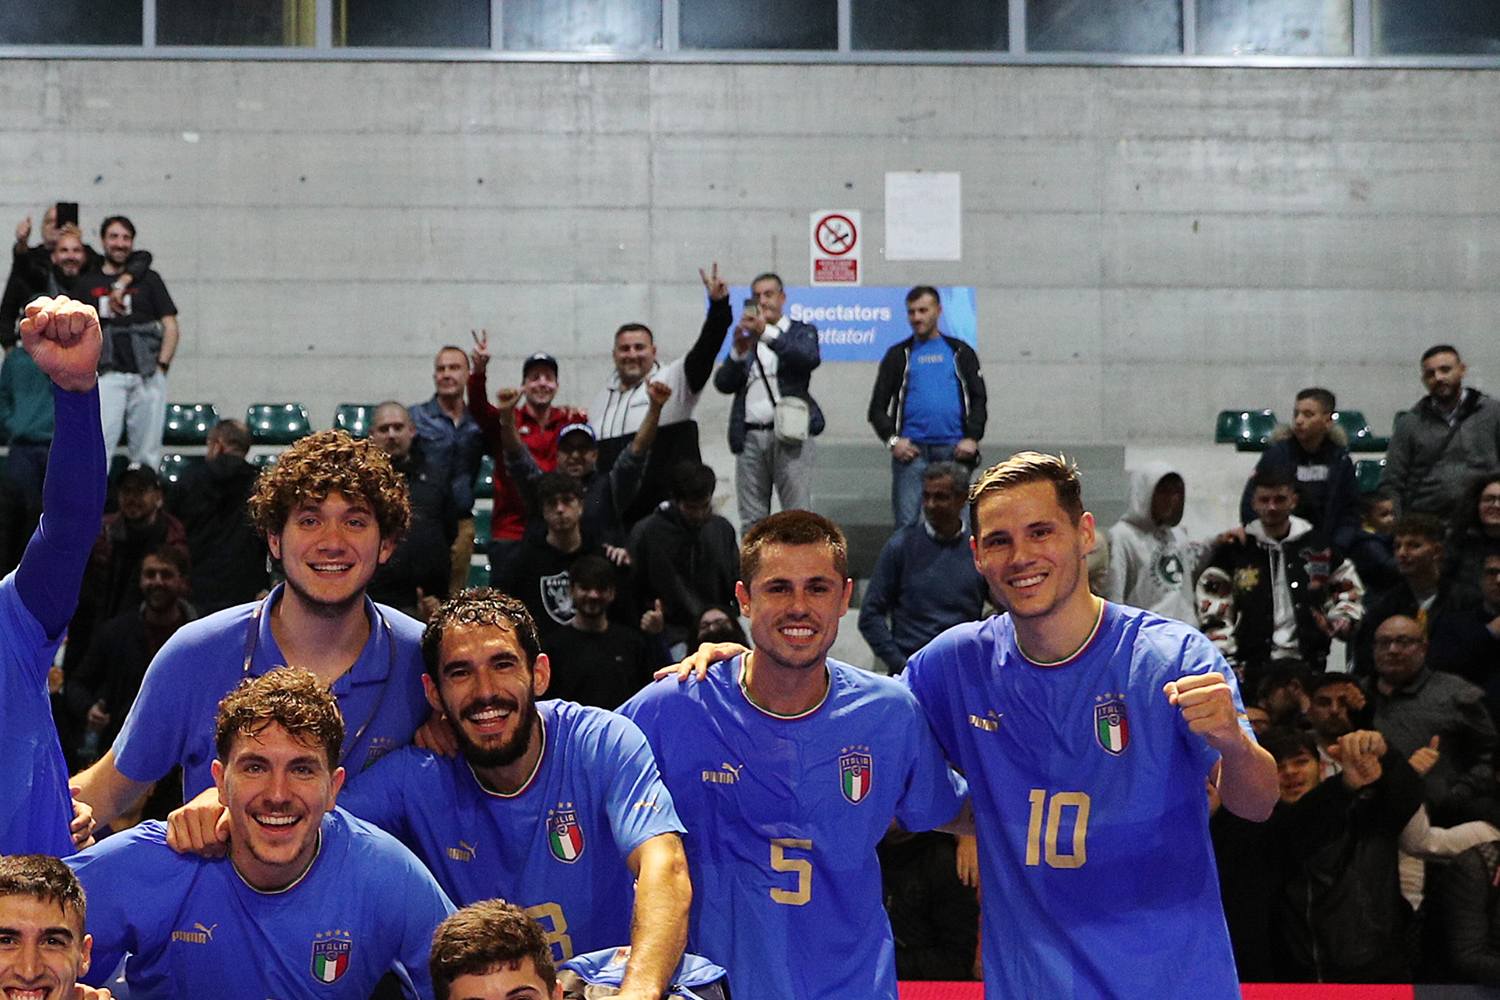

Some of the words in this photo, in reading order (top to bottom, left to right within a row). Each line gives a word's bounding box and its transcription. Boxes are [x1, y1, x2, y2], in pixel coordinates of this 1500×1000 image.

[789, 303, 892, 323] Spectators
[842, 756, 869, 767] ITALIA
[702, 770, 734, 784] PUMA
[1025, 788, 1091, 869] 10
[770, 837, 812, 906] 5
[172, 930, 207, 944] PUMA
[315, 942, 349, 952] ITALIA
